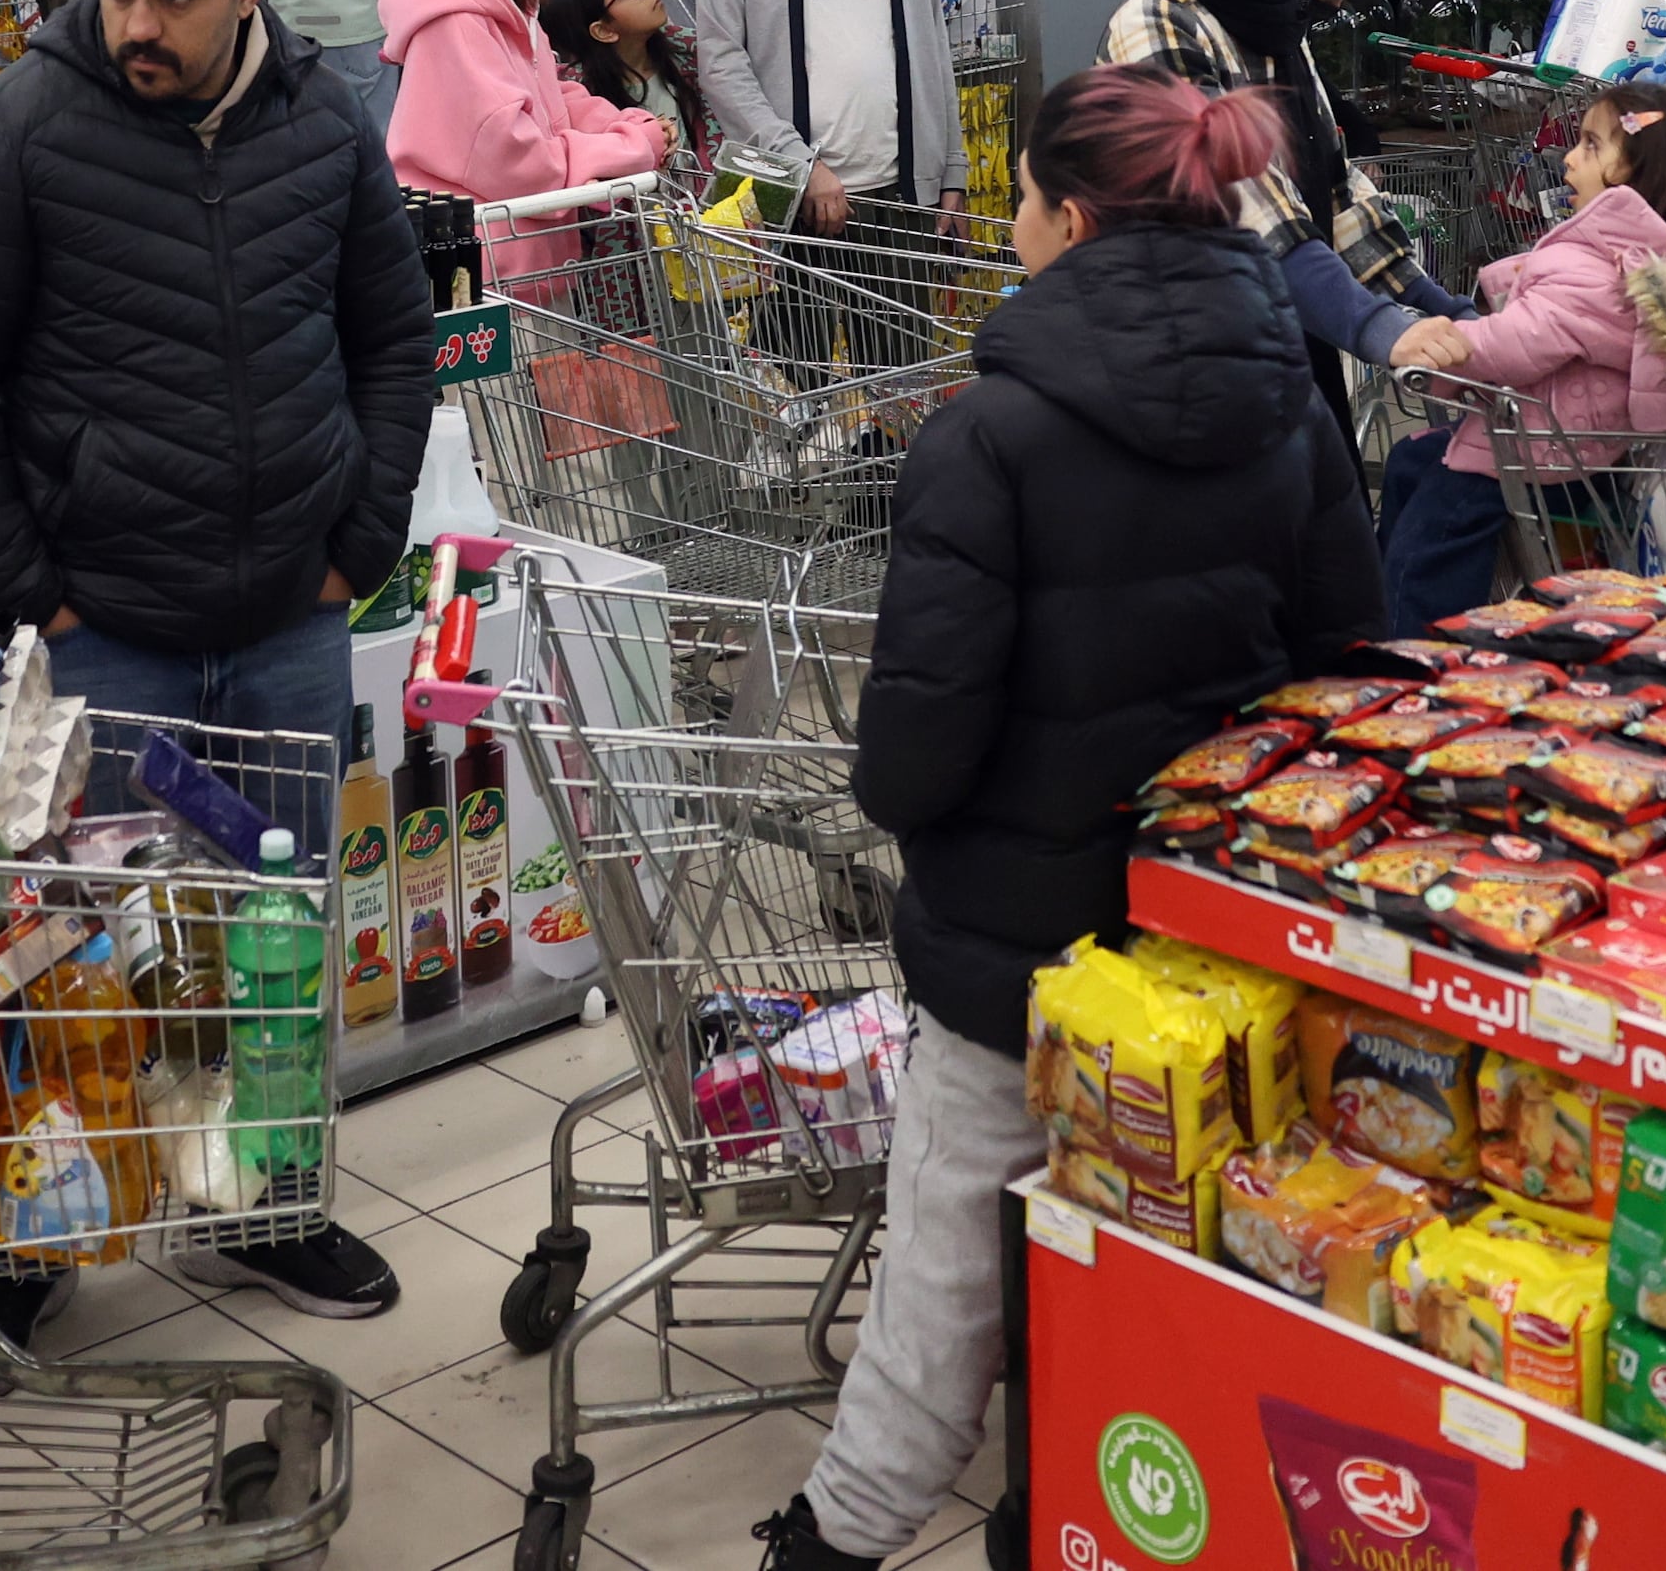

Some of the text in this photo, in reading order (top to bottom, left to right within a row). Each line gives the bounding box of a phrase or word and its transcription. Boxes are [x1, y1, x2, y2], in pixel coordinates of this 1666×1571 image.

[468, 805, 498, 832] وردا
[409, 824, 441, 851] وردا
[348, 841, 381, 869] وردا
[466, 852, 502, 871] DATE SYRUP
[471, 864, 497, 879] VINEGAR
[406, 874, 446, 896] BALSAMIC
[355, 893, 378, 909] APPLE
[410, 887, 444, 909] VINEGAR
[351, 904, 383, 922] VINEGAR
[1132, 1456, 1176, 1506] NO
